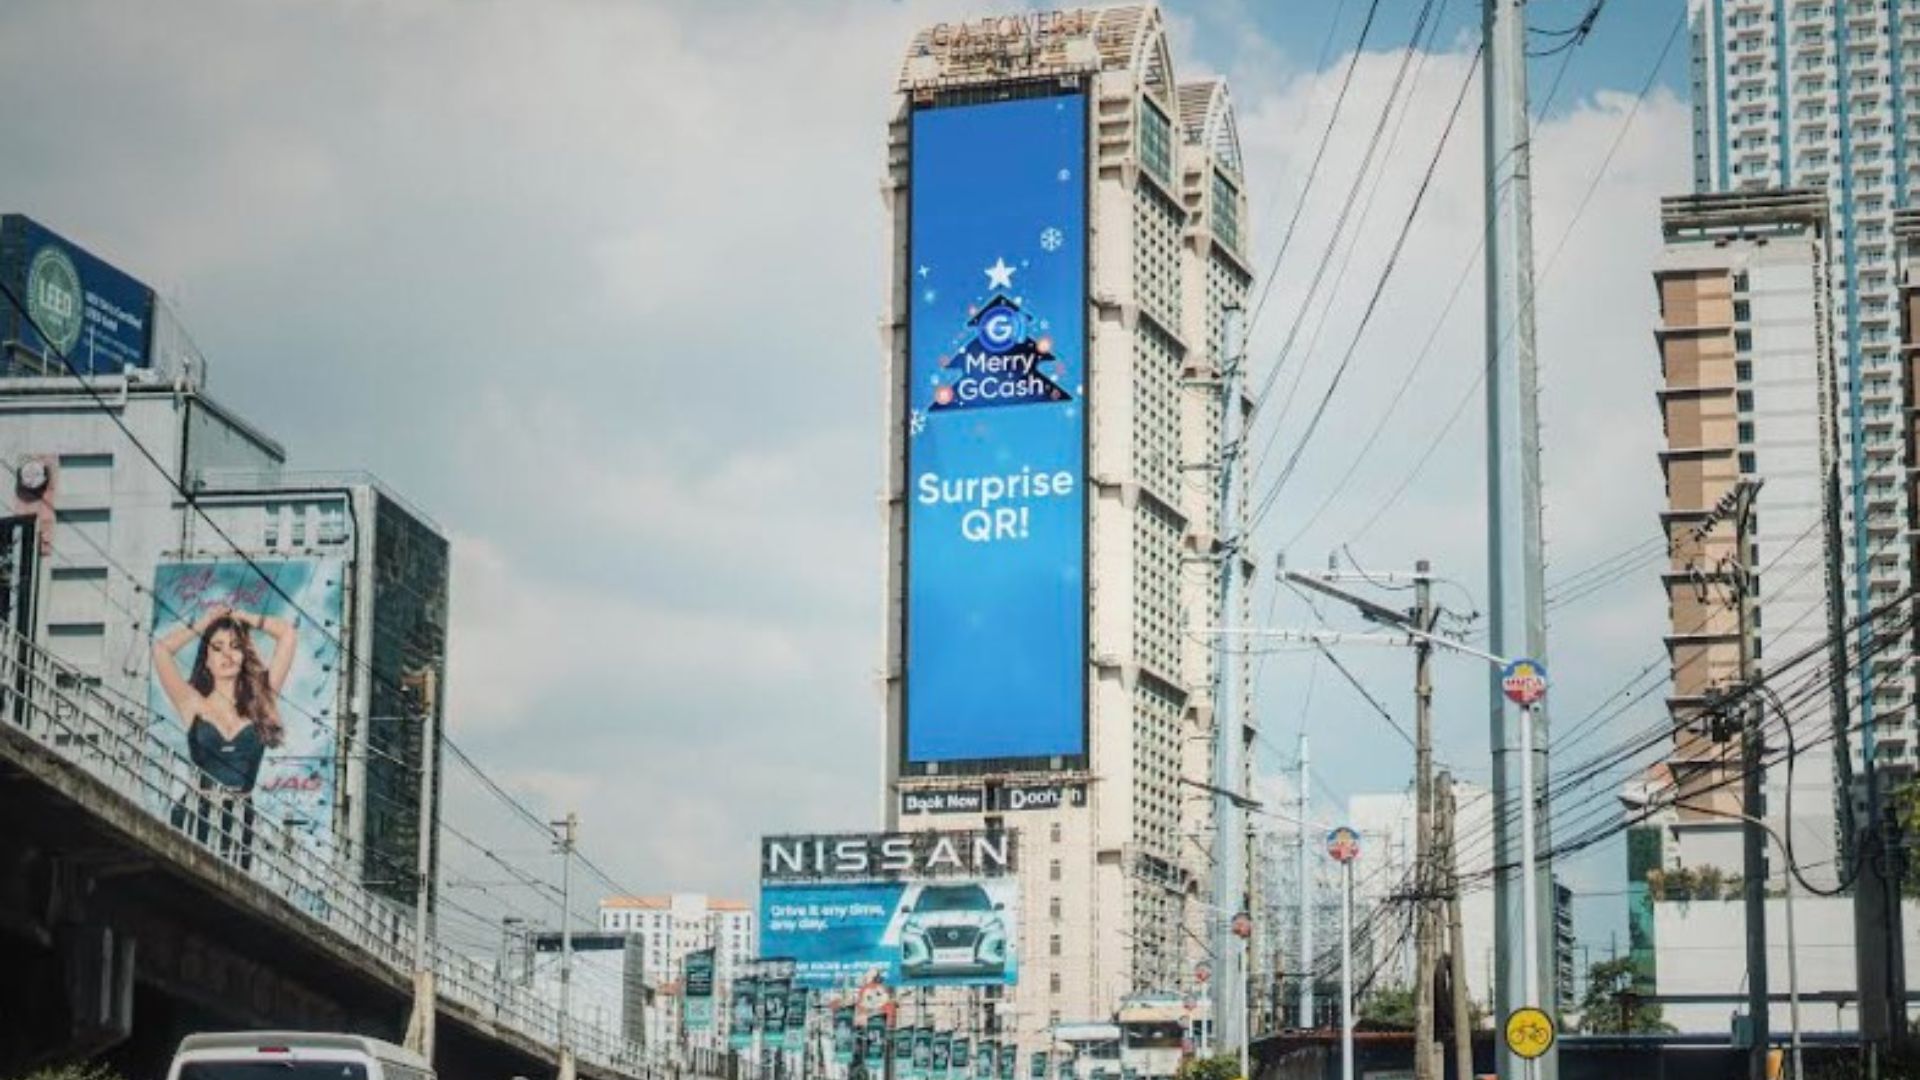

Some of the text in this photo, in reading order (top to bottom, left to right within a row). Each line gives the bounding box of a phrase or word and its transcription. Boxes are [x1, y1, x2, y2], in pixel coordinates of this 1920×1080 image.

[39, 279, 72, 318] LEED
[986, 315, 1012, 342] G
[966, 353, 1035, 374] Merry
[958, 376, 1043, 400] GCash
[918, 465, 1074, 508] Surprise
[961, 506, 1030, 542] QR!
[906, 793, 980, 810] Book Now
[770, 836, 1009, 872] NISSAN
[770, 904, 806, 917] Drive
[821, 905, 848, 920] any
[769, 920, 796, 933] any
